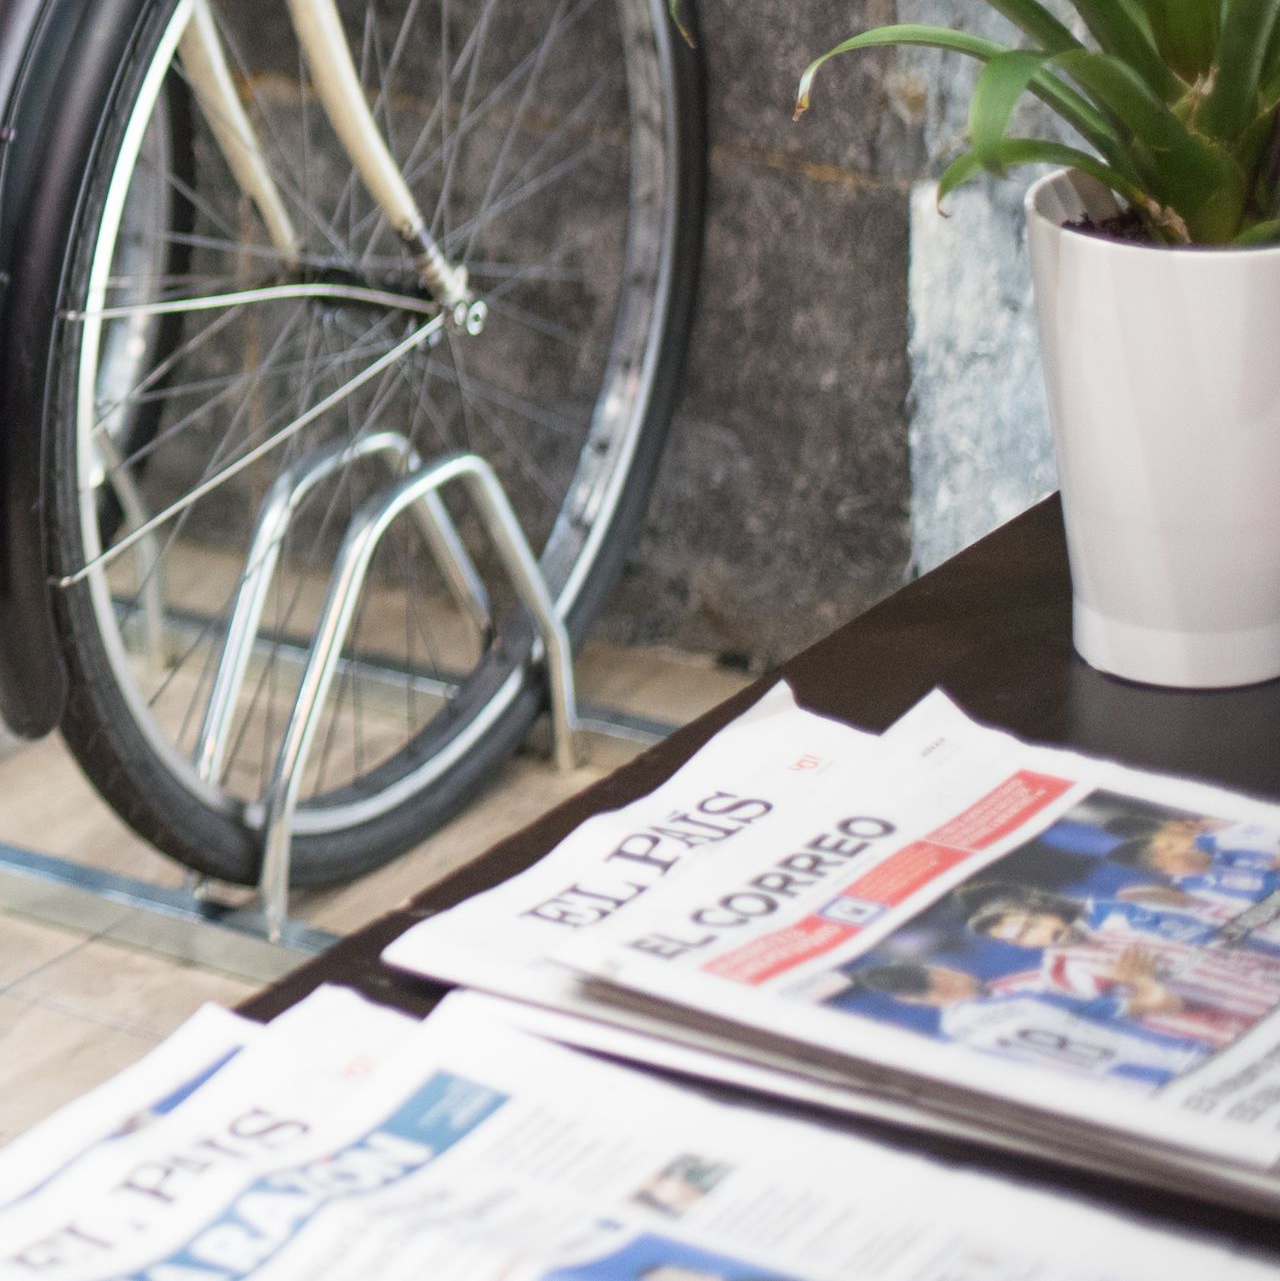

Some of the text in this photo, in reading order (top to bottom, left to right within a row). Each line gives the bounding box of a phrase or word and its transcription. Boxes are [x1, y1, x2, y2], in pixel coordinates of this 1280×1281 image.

[519, 880, 649, 928] EL
[628, 932, 718, 961] EL
[689, 816, 898, 929] CORREO
